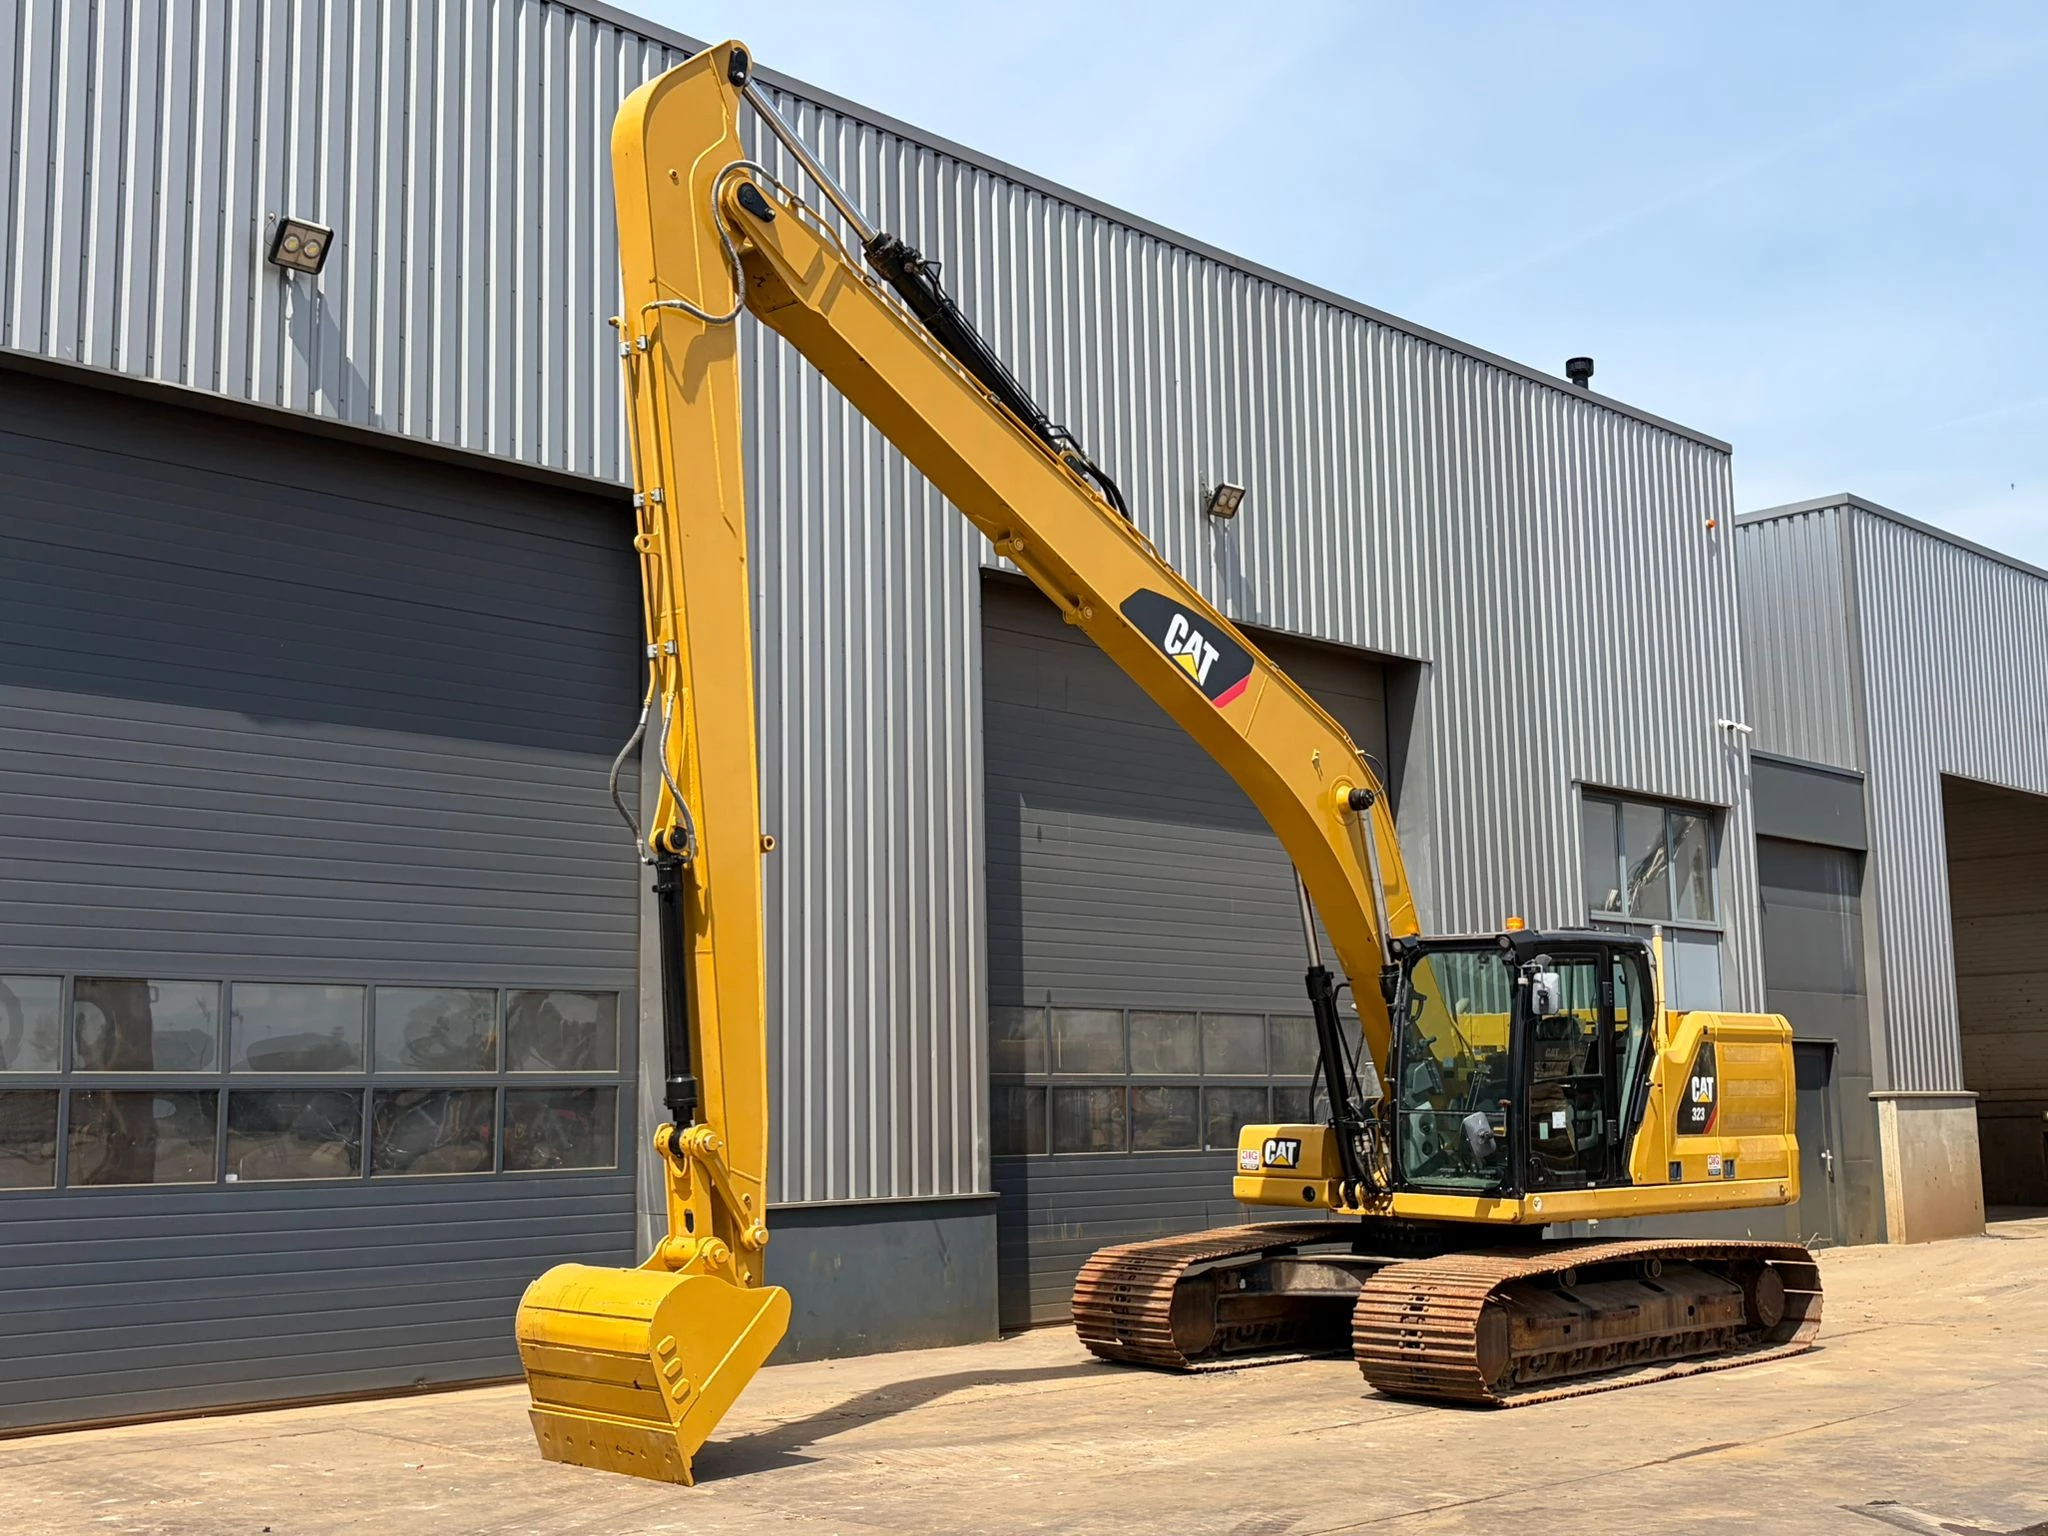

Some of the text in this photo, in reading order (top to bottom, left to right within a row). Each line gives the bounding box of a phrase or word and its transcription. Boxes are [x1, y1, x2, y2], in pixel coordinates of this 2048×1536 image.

[1164, 613, 1220, 687] CAT
[1691, 1076, 1714, 1103] CAT
[1691, 1106, 1706, 1122] 323
[1264, 1139, 1297, 1166] CAT
